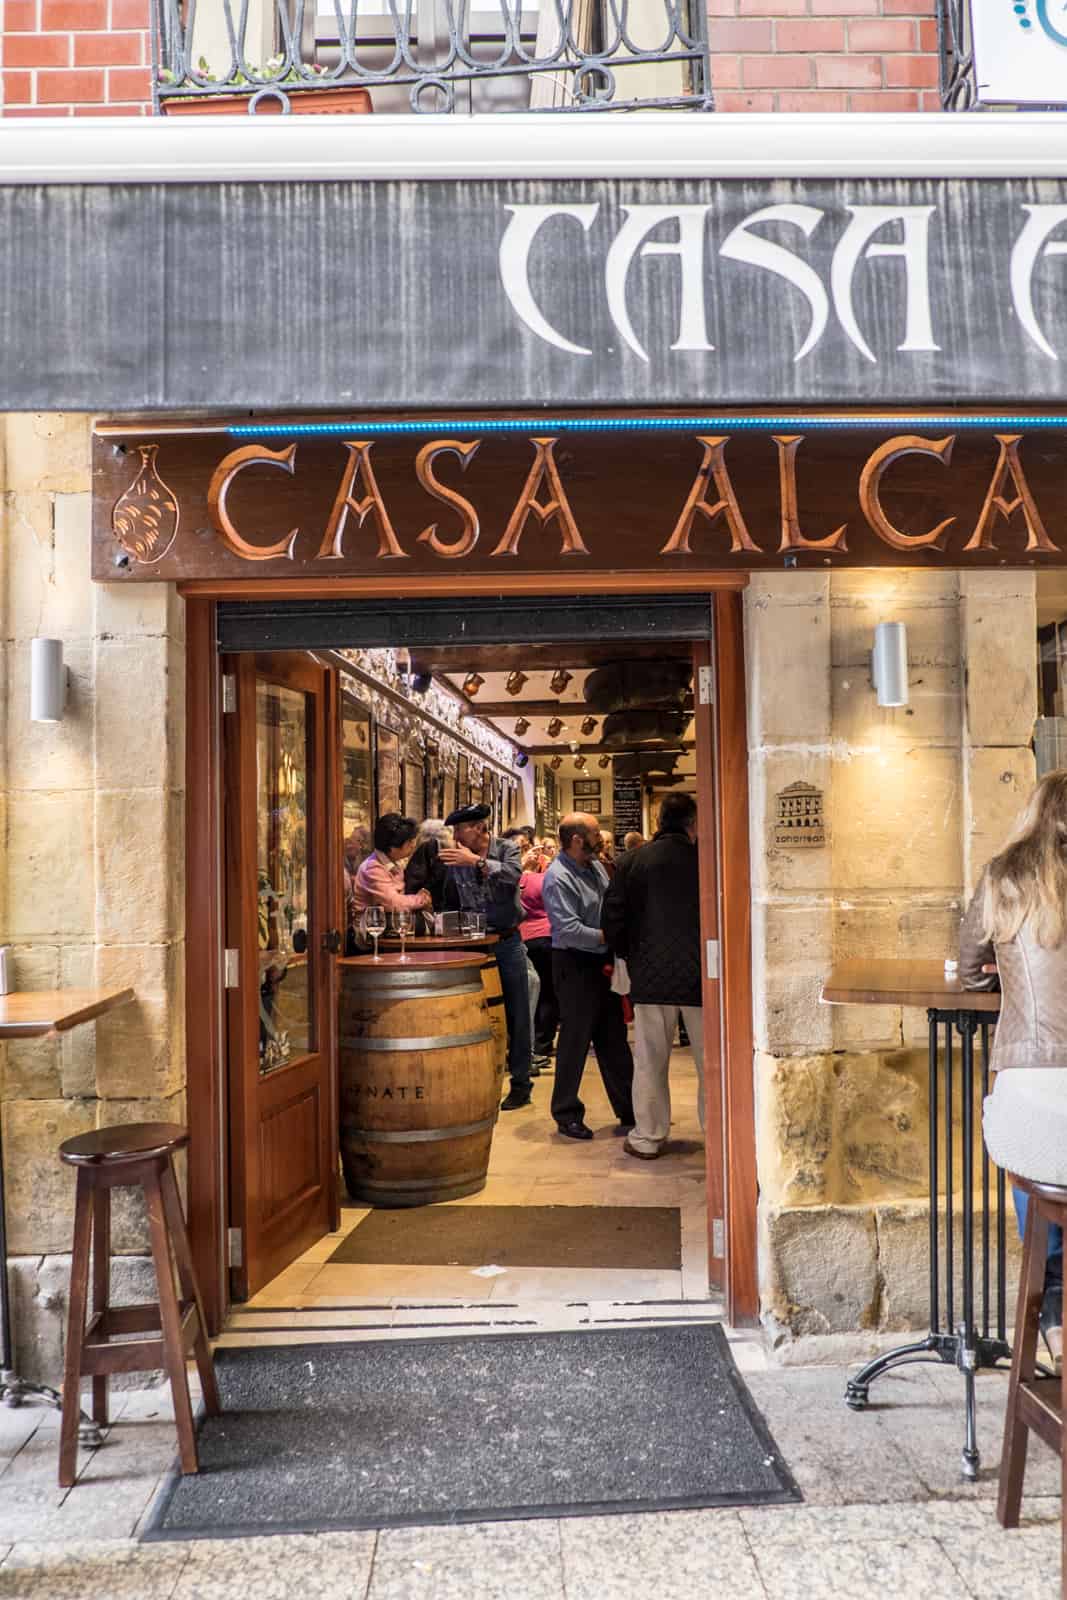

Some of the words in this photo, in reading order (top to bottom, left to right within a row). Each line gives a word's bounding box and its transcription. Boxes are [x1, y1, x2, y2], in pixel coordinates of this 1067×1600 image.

[499, 202, 943, 362] CASA
[207, 437, 592, 561] CASA
[659, 434, 1062, 556] ALCA
